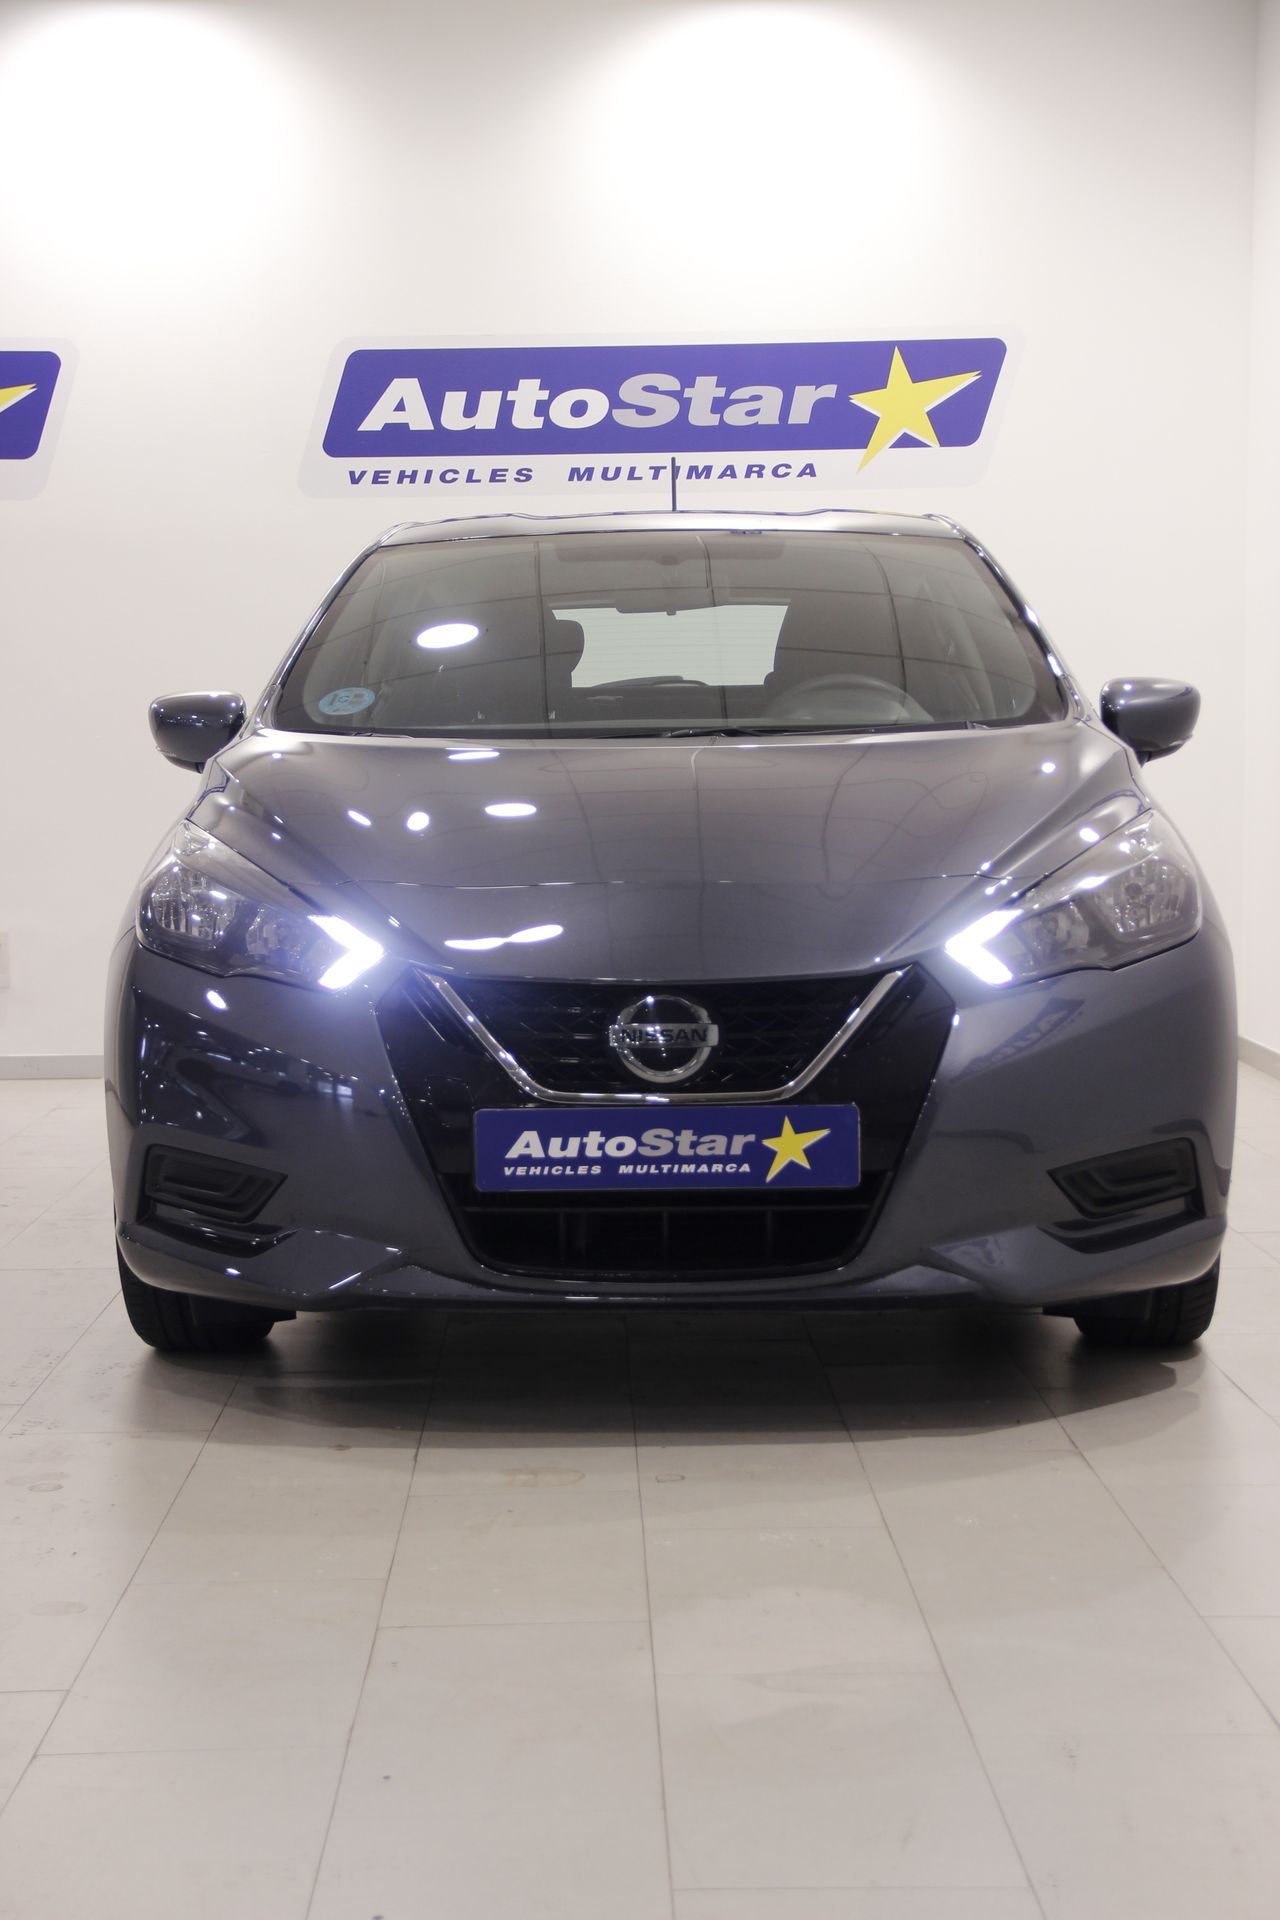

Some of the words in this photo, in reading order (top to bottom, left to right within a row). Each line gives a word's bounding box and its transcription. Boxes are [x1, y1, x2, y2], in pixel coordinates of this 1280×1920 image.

[357, 373, 838, 432] AutoStar
[348, 468, 534, 485] VEHICLES
[621, 1028, 708, 1043] NISSAN
[504, 1128, 756, 1158] AutoStar
[503, 1164, 602, 1176] VEHICLES
[618, 1163, 752, 1174] MULTIMARCA
